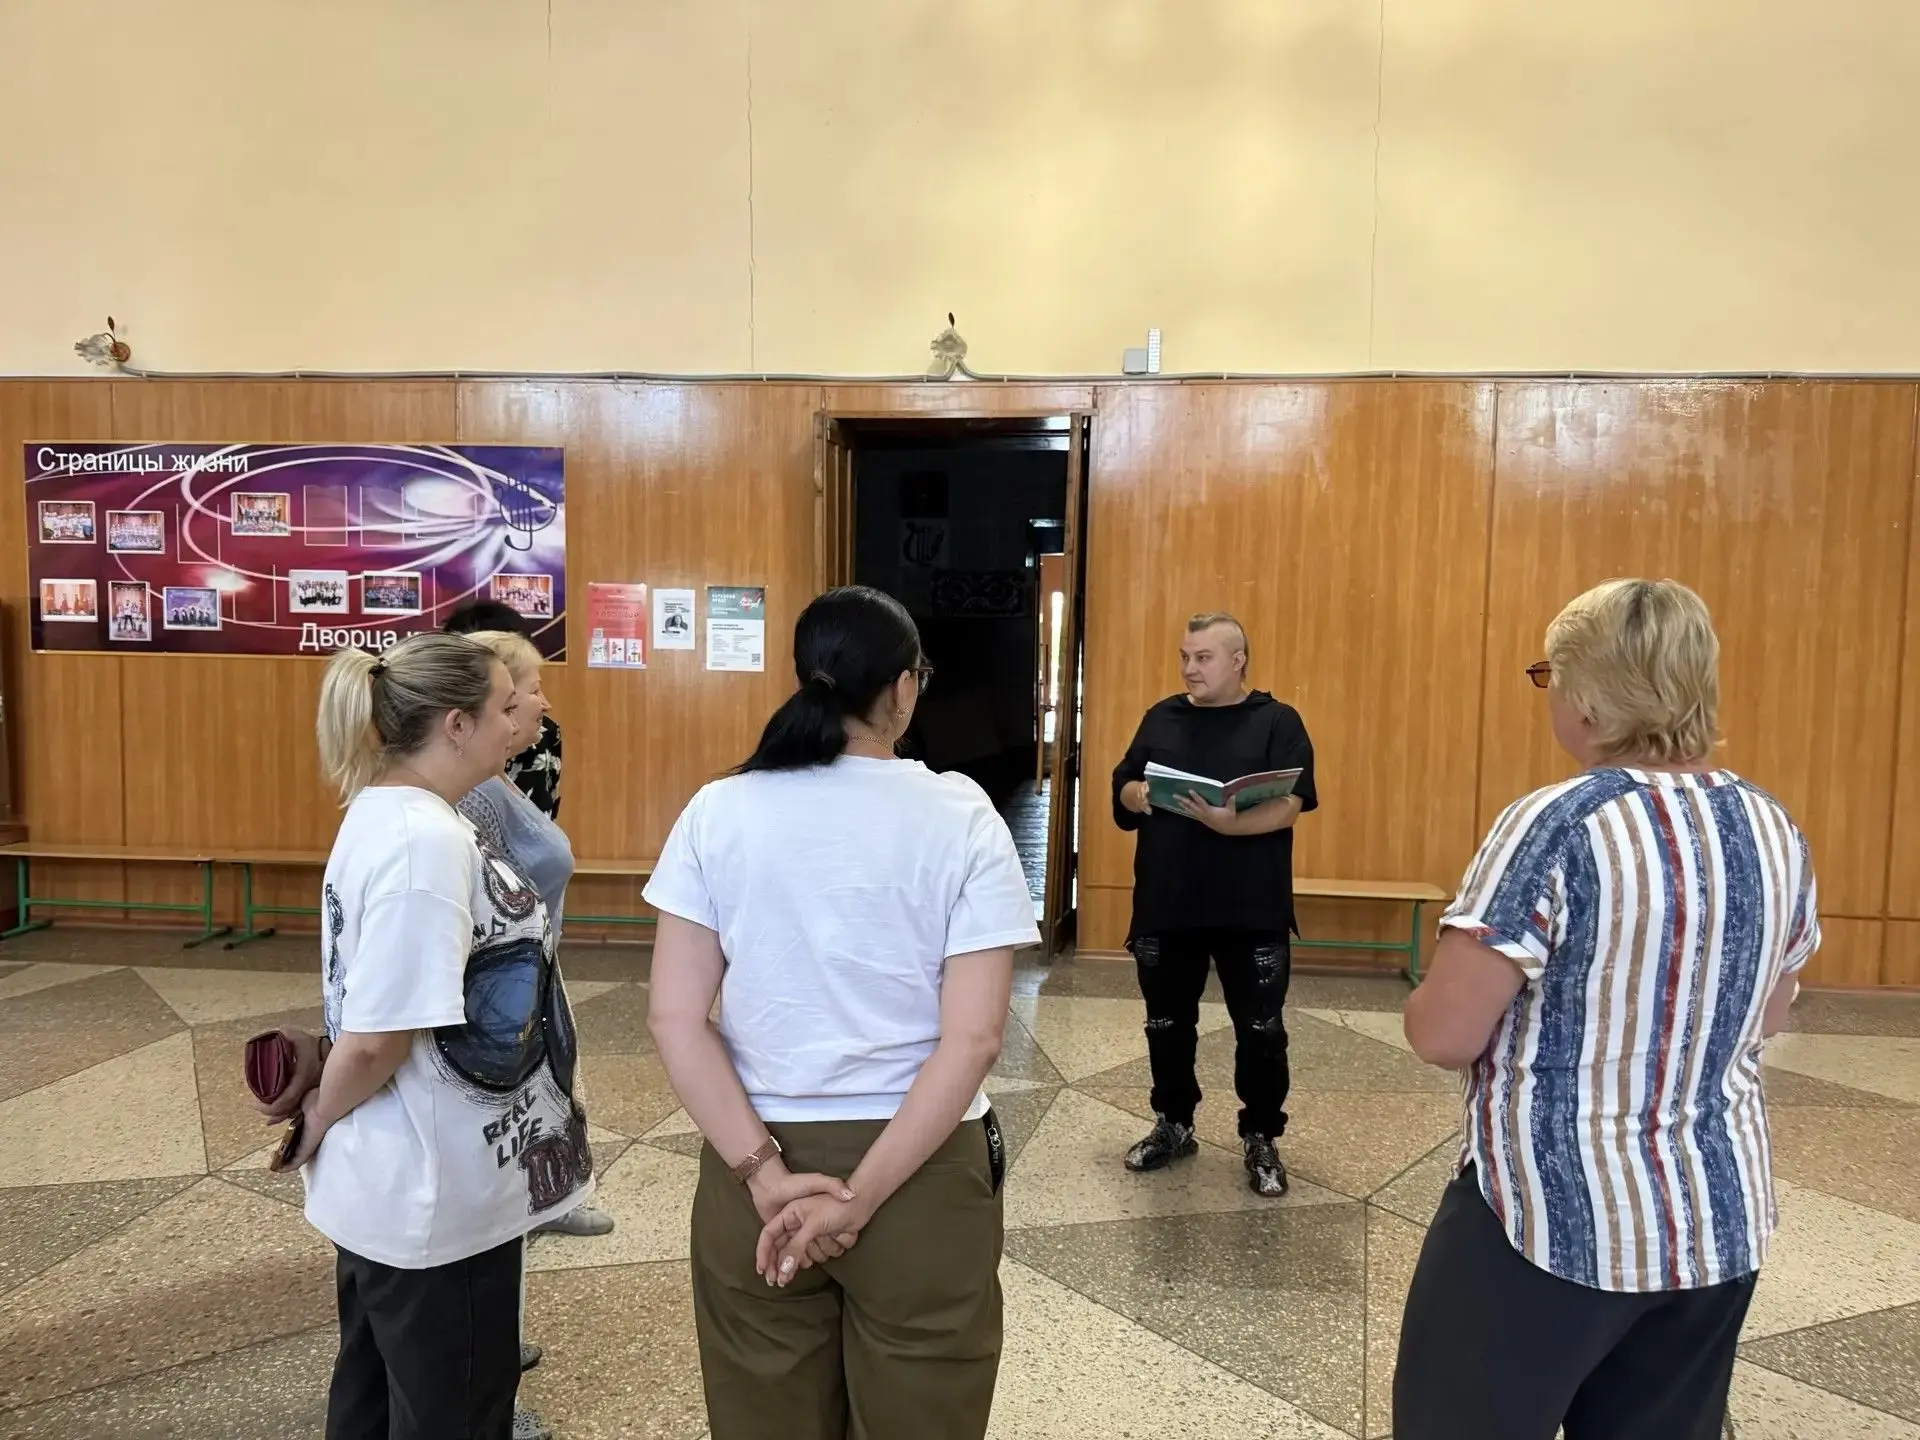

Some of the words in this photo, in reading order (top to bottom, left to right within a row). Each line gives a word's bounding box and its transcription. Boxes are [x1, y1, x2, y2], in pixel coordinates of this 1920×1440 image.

[37, 447, 163, 476] Страницы
[171, 453, 248, 473] жизни
[299, 622, 397, 652] Дворца
[483, 1088, 537, 1146] REAL
[497, 1117, 543, 1169] LIFE
